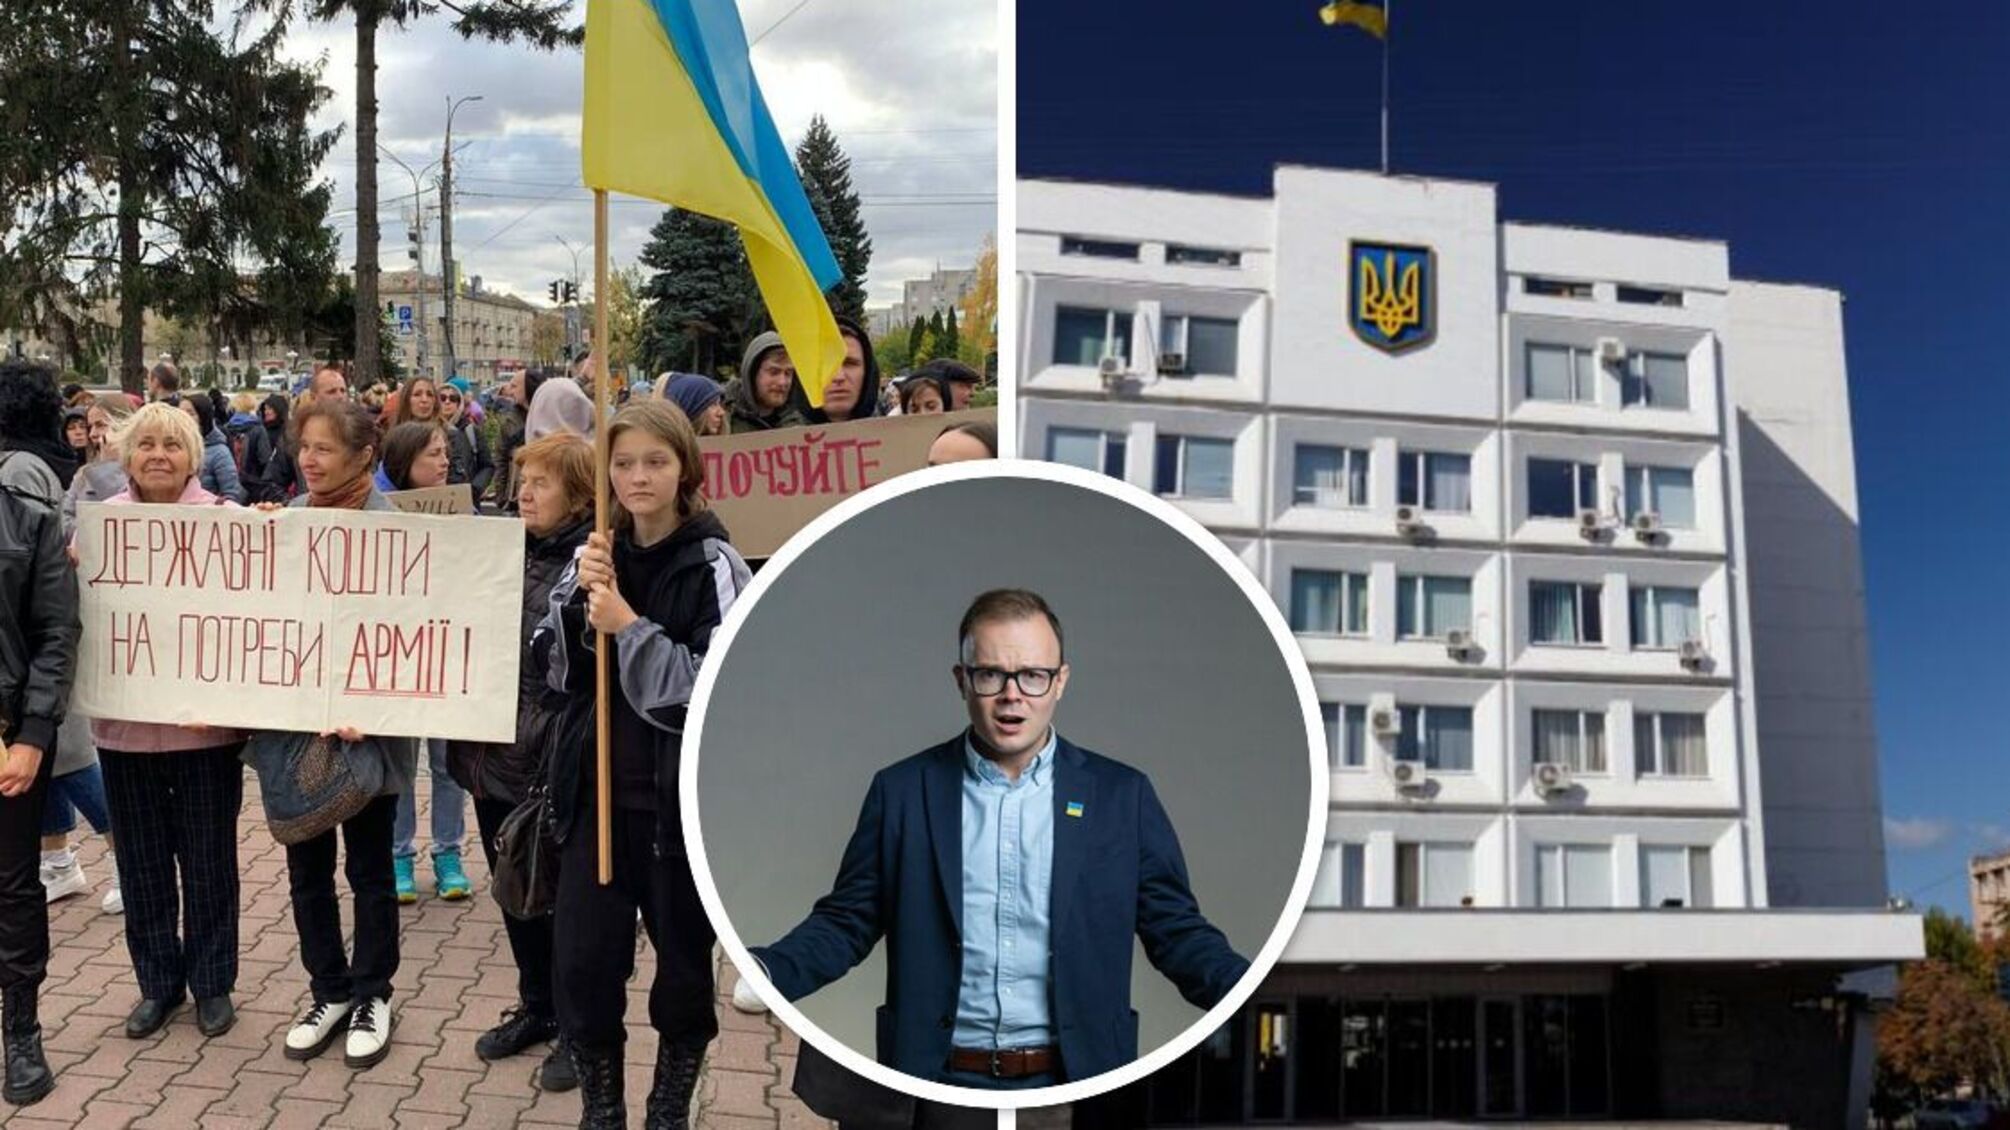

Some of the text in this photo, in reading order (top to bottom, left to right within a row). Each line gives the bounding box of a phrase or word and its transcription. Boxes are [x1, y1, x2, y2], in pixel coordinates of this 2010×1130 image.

[701, 430, 882, 500] ПОЧУЙТЕ
[88, 518, 430, 595] ДЕРЖАВНІ КОШТИ
[111, 612, 155, 676] НА
[178, 614, 323, 687] ПОТРЕБИ
